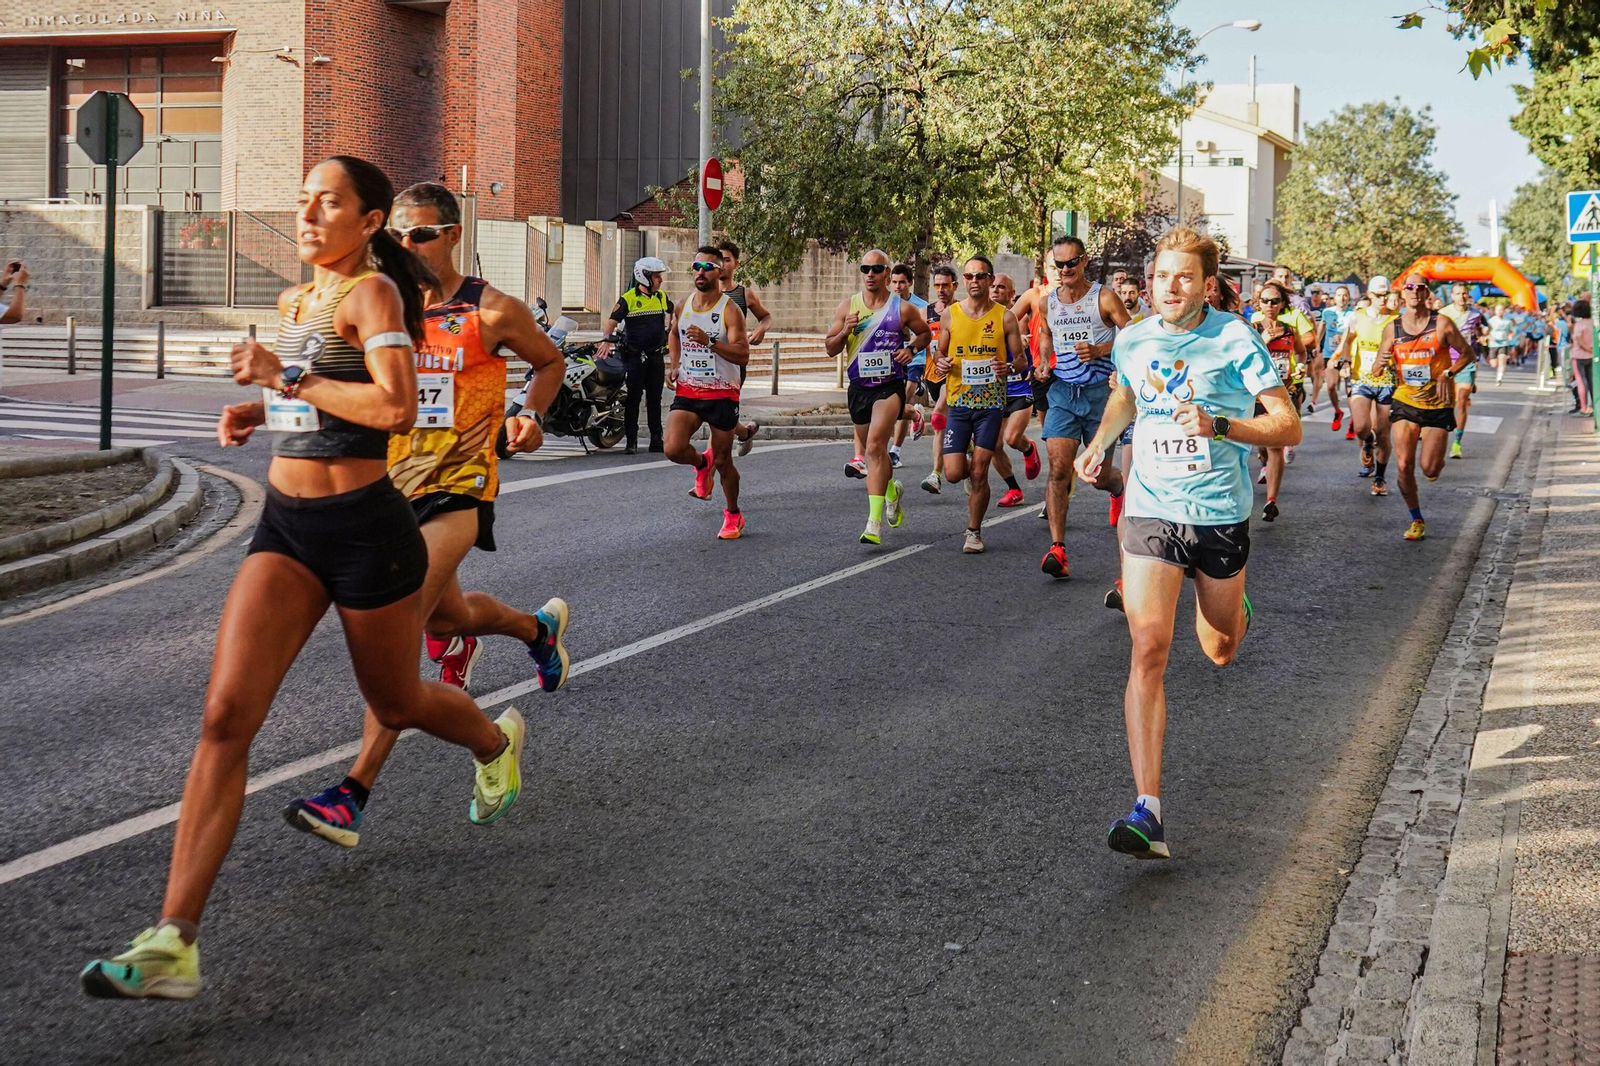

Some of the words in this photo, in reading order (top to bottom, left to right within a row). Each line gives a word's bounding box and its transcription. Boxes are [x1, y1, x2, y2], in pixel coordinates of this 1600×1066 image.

[23, 12, 158, 27] INMACULADA
[1053, 316, 1092, 326] MARACENA
[1062, 331, 1089, 341] 1492
[968, 345, 997, 355] Vigilsa
[413, 346, 464, 372] UBIA
[690, 360, 708, 368] 165
[864, 358, 883, 367] 390
[966, 366, 991, 375] 1380
[1407, 370, 1423, 378] 542
[418, 388, 442, 405] 47
[1152, 438, 1198, 455] 1178
